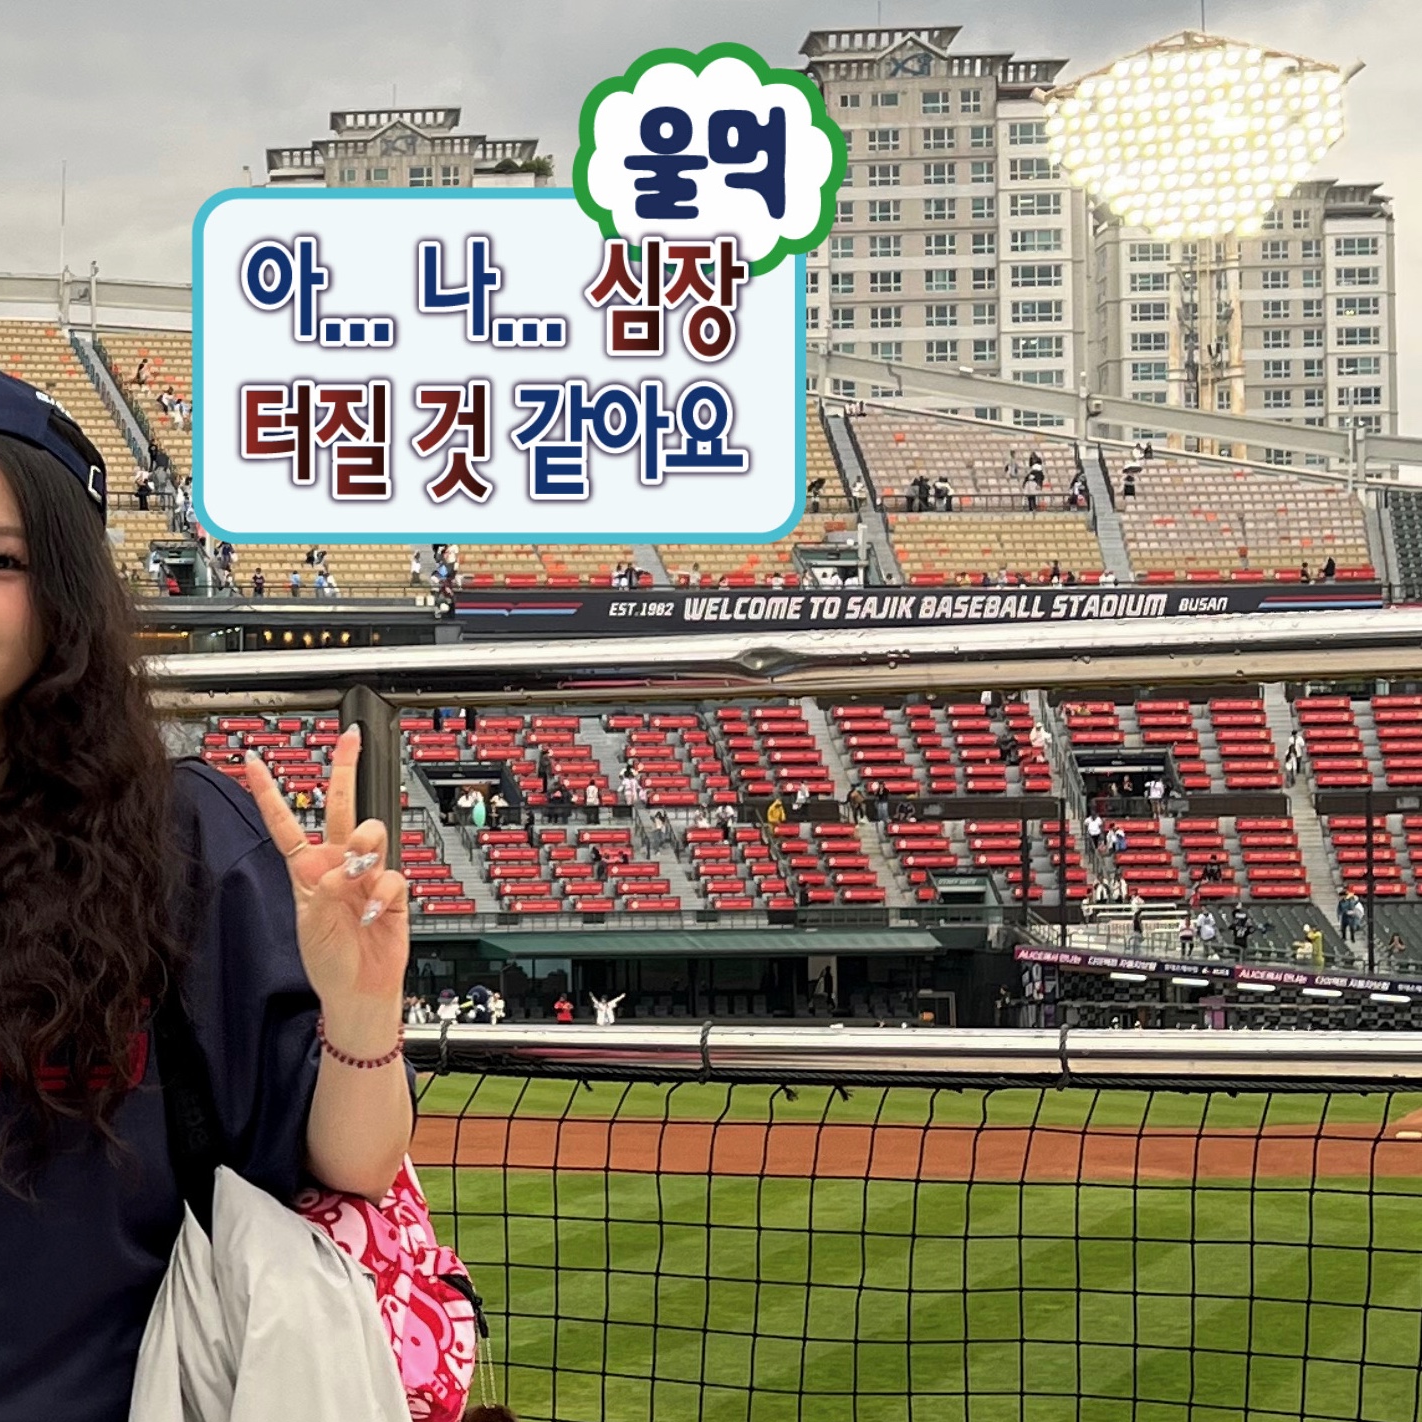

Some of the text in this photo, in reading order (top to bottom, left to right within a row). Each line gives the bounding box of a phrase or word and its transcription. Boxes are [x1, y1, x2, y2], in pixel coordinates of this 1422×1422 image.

[609, 593, 1228, 622] EST.1982 WELCOME TO SAJIK BASEBALL STADIUM BUSAN
